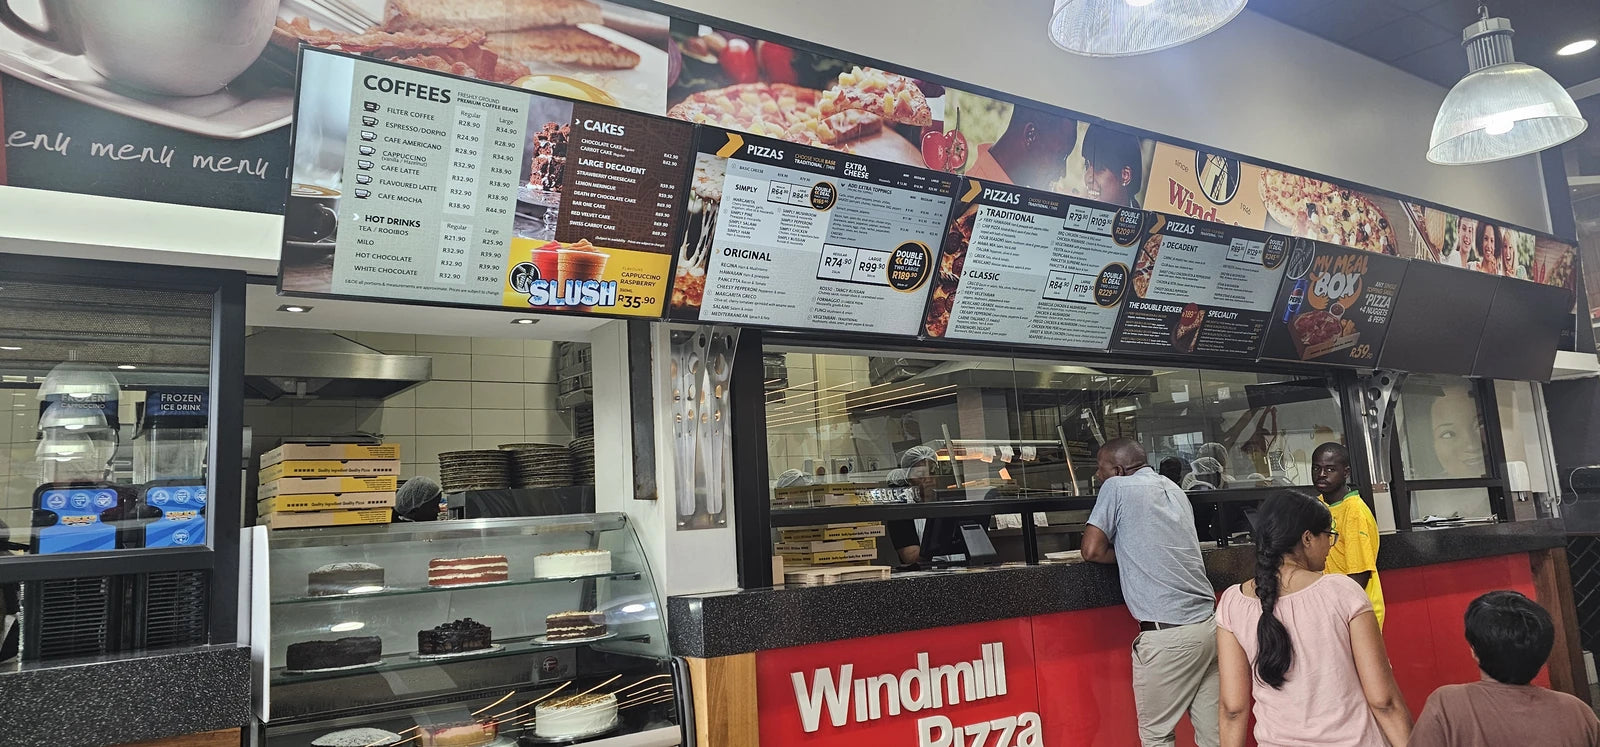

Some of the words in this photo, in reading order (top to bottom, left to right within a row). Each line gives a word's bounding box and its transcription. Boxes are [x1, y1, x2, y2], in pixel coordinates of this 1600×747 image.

[364, 74, 451, 104] COFFEES
[458, 92, 478, 100] FRESHLY
[479, 95, 500, 104] GROUND
[457, 98, 481, 107] PREMIUM
[482, 102, 501, 110] COFFEE
[387, 107, 408, 116] FILTER
[410, 111, 434, 120] COFFEE
[460, 110, 481, 119] Regular
[459, 120, 481, 128] R28.90
[499, 117, 514, 125] Large
[385, 122, 446, 137] ESPRESSO/DORPIO
[496, 127, 517, 135] R34.90
[584, 119, 625, 136] CAKES
[384, 136, 401, 145] CAFE
[403, 140, 442, 150] AMERICANO
[457, 134, 479, 142] R24.90
[582, 139, 609, 147] CHOCOLATE
[495, 140, 515, 148] R28.90
[5, 130, 70, 155] enu
[91, 140, 176, 167] menu
[193, 152, 269, 179] menu
[383, 151, 427, 162] CAPPUCCINO
[455, 147, 477, 156] R28.90
[747, 144, 784, 160] PIZZAS
[493, 154, 513, 162] R34.90
[794, 158, 822, 168] TRADITIONAL
[381, 165, 398, 173] CAFE
[454, 161, 475, 170] R32.90
[579, 158, 603, 168] LARGE
[605, 161, 646, 175] DECADENT
[845, 162, 867, 172] EXTRA
[1175, 160, 1189, 172] since
[491, 167, 512, 175] R38.90
[844, 168, 869, 180] CHEESE
[452, 175, 474, 183] R32.90
[577, 170, 607, 179] STRAWBERRY
[608, 175, 636, 183] CHEESECAKE
[380, 179, 417, 189] FLAVOURED
[489, 180, 510, 188] R38.90
[735, 184, 758, 192] SIMPLY
[450, 188, 472, 196] R32.90
[983, 188, 1020, 204] PIZZAS
[378, 193, 396, 201] CAFE
[397, 196, 422, 204] MOCHA
[597, 193, 623, 202] CHOCOLATE
[449, 202, 470, 210] R38.90
[1240, 203, 1251, 215] 1946
[986, 208, 1035, 223] TRADITIONAL
[1069, 212, 1088, 222] R79.90
[1120, 210, 1140, 219] DOUBLE
[365, 215, 385, 224] HOT
[387, 217, 421, 228] DRINKS
[1090, 217, 1112, 226] R109.90
[1125, 217, 1138, 225] DEAL
[378, 227, 409, 236] ROOIBOS
[447, 223, 467, 231] Regular
[1166, 221, 1195, 235] PIZZAS
[442, 247, 464, 255] R32.90
[1167, 242, 1199, 253] DECADENT
[372, 253, 412, 262] CHOCOLATE
[724, 248, 771, 261] ORIGINAL
[896, 250, 923, 260] DOUBLE
[824, 257, 852, 268] R74.90
[859, 262, 885, 272] R99.90
[1313, 255, 1333, 273] MY
[1333, 254, 1368, 275] MEAL
[378, 267, 417, 276] CHOCOLATE
[621, 272, 661, 281] CAPPUCCINO
[892, 271, 917, 280] R189.90
[969, 270, 1000, 281] CLASSIC
[1103, 271, 1123, 280] DOUBLE
[1049, 280, 1069, 289] R84.90
[1073, 284, 1094, 293] R119.90
[1314, 272, 1361, 299] BOX
[529, 279, 617, 307] SLUSH
[618, 295, 656, 308] R35.90
[1129, 301, 1139, 310] THE
[1141, 303, 1162, 312] DOUBLE
[1162, 305, 1183, 313] DECKER
[1366, 306, 1388, 316] NUGGETS
[1208, 310, 1238, 320] SPECIALITY
[161, 393, 202, 403] FROZEN
[791, 642, 1007, 733] Windmill
